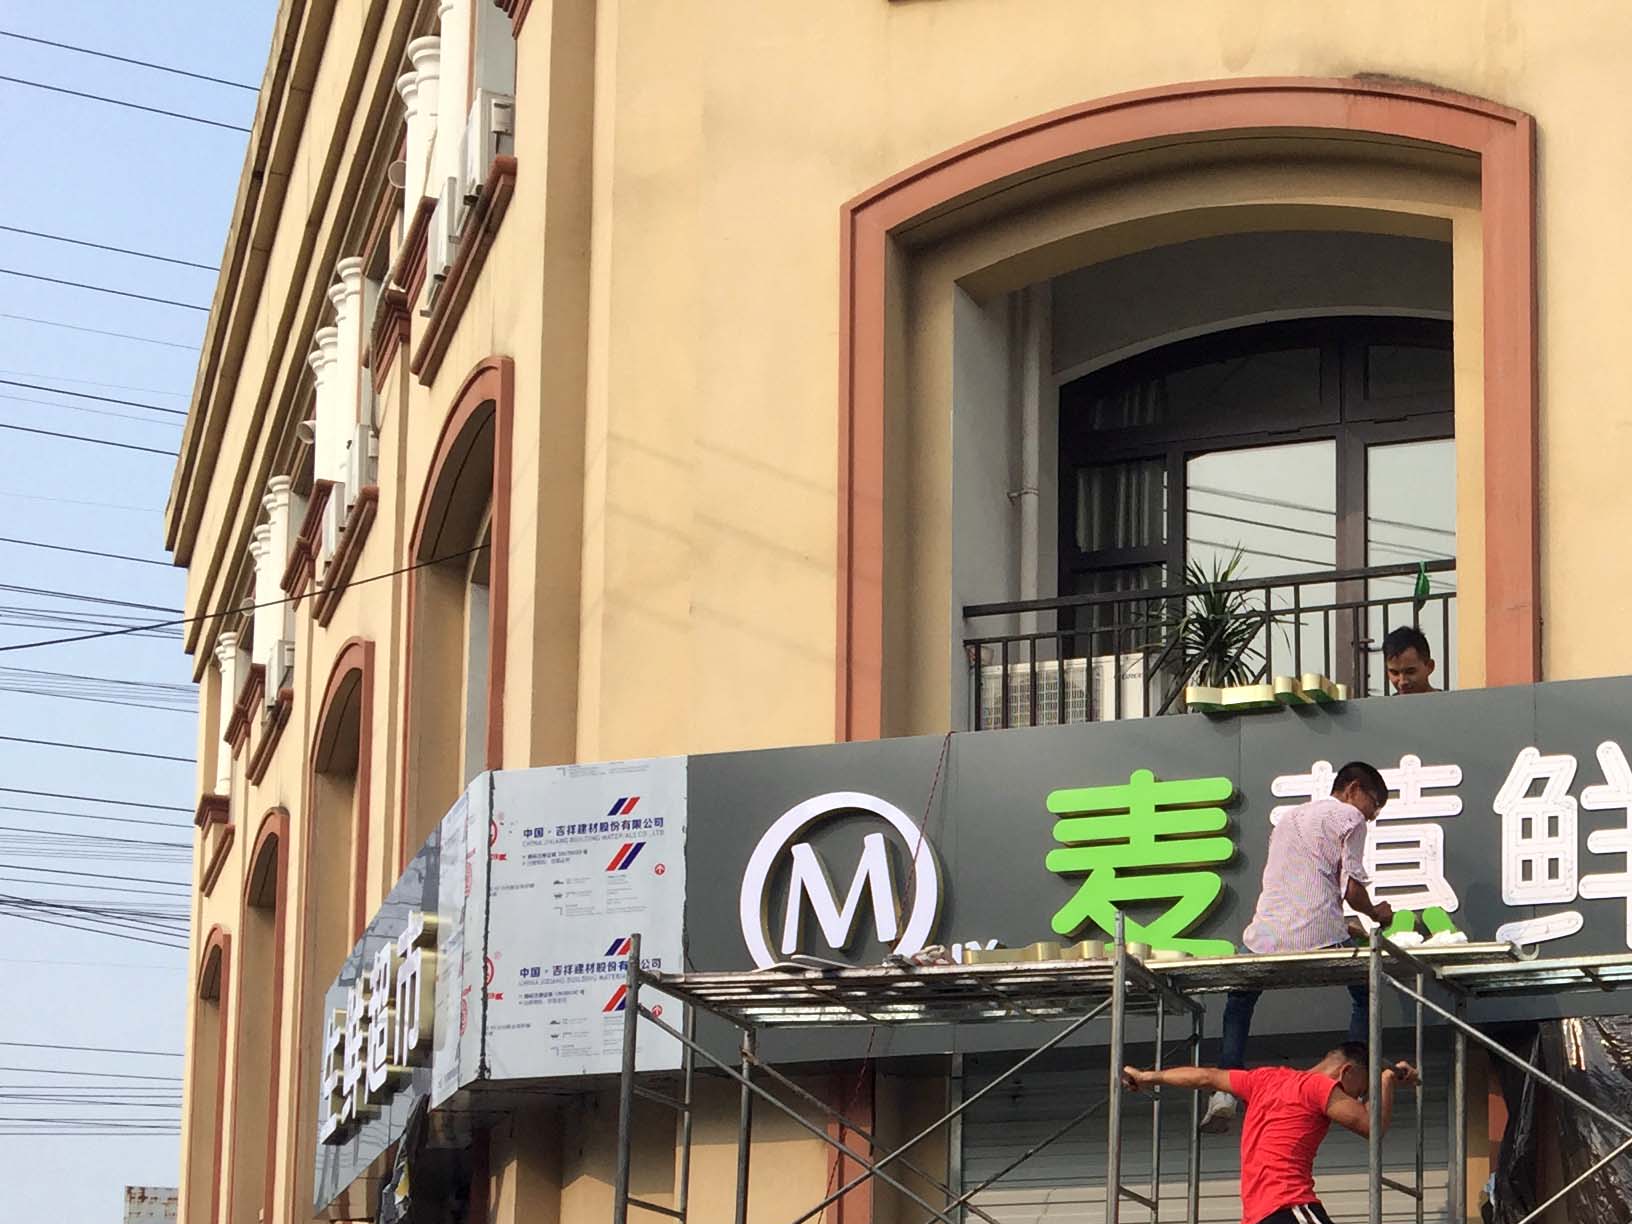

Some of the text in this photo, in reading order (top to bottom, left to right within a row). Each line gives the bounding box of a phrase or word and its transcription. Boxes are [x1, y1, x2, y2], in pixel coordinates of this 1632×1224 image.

[519, 958, 661, 978] 中国·吉祥建材股份有公司
